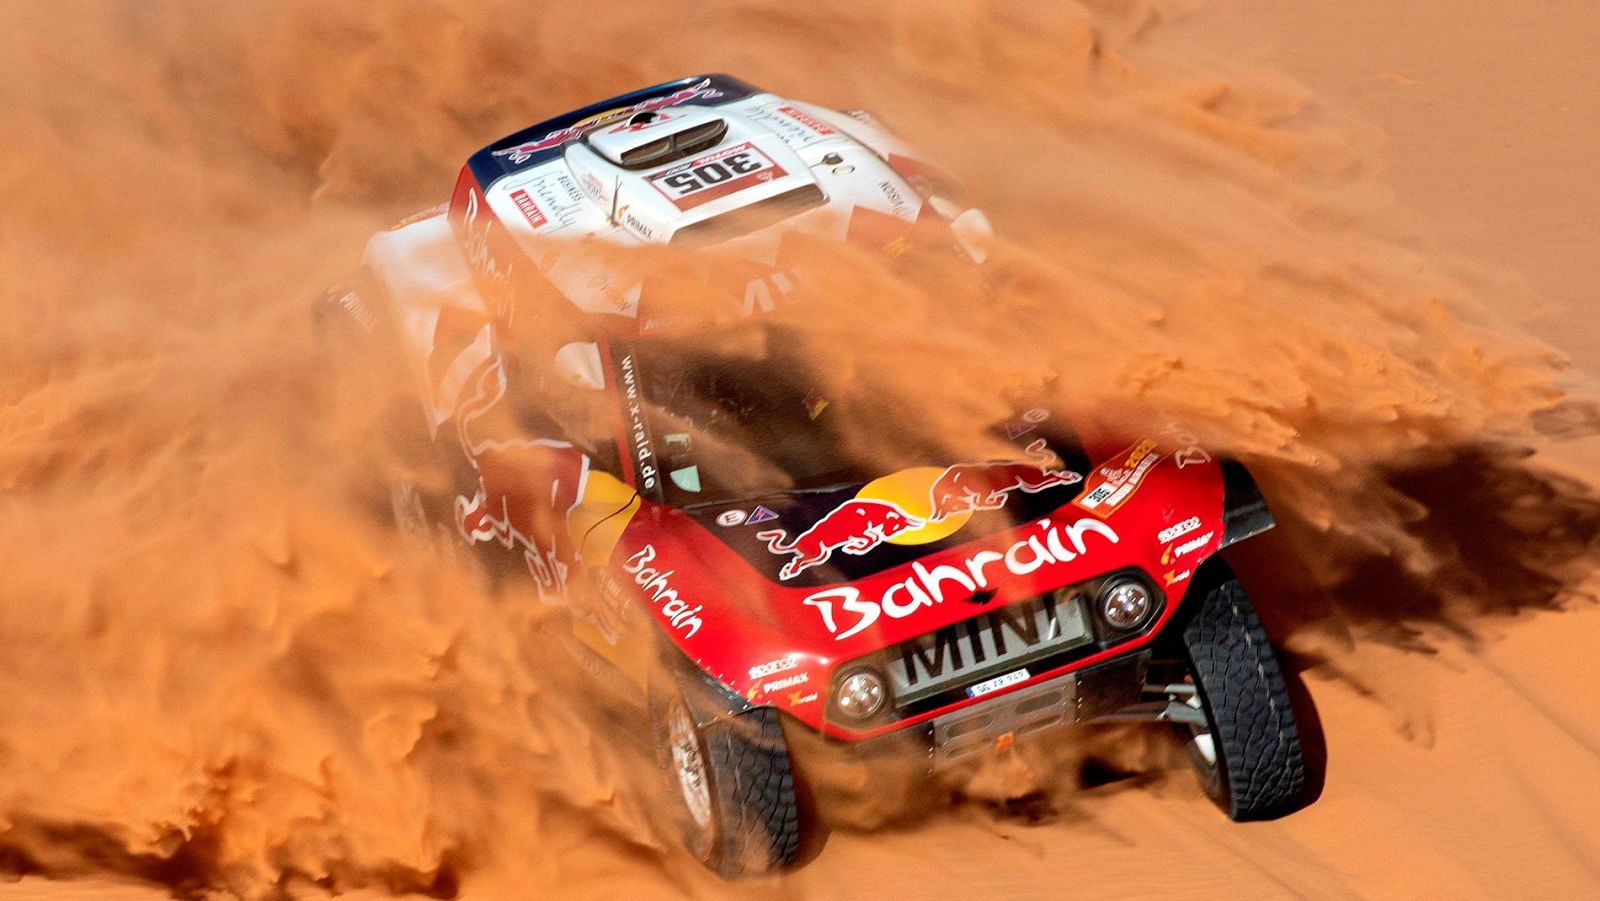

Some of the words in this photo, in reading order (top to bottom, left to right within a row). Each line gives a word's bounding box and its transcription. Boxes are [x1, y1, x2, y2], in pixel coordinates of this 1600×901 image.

[663, 151, 763, 195] 305
[513, 191, 546, 227] BAHRAIN
[626, 213, 653, 239] PRIMAX
[622, 355, 656, 489] www.x-raid.de
[1087, 486, 1111, 503] 305
[1157, 515, 1202, 544] sparco
[1174, 531, 1214, 558] PRIMAX
[622, 544, 703, 639] Bahrain
[803, 518, 1119, 641] Bahrain
[901, 593, 1063, 687] MINI
[763, 671, 810, 694] PRIMAX
